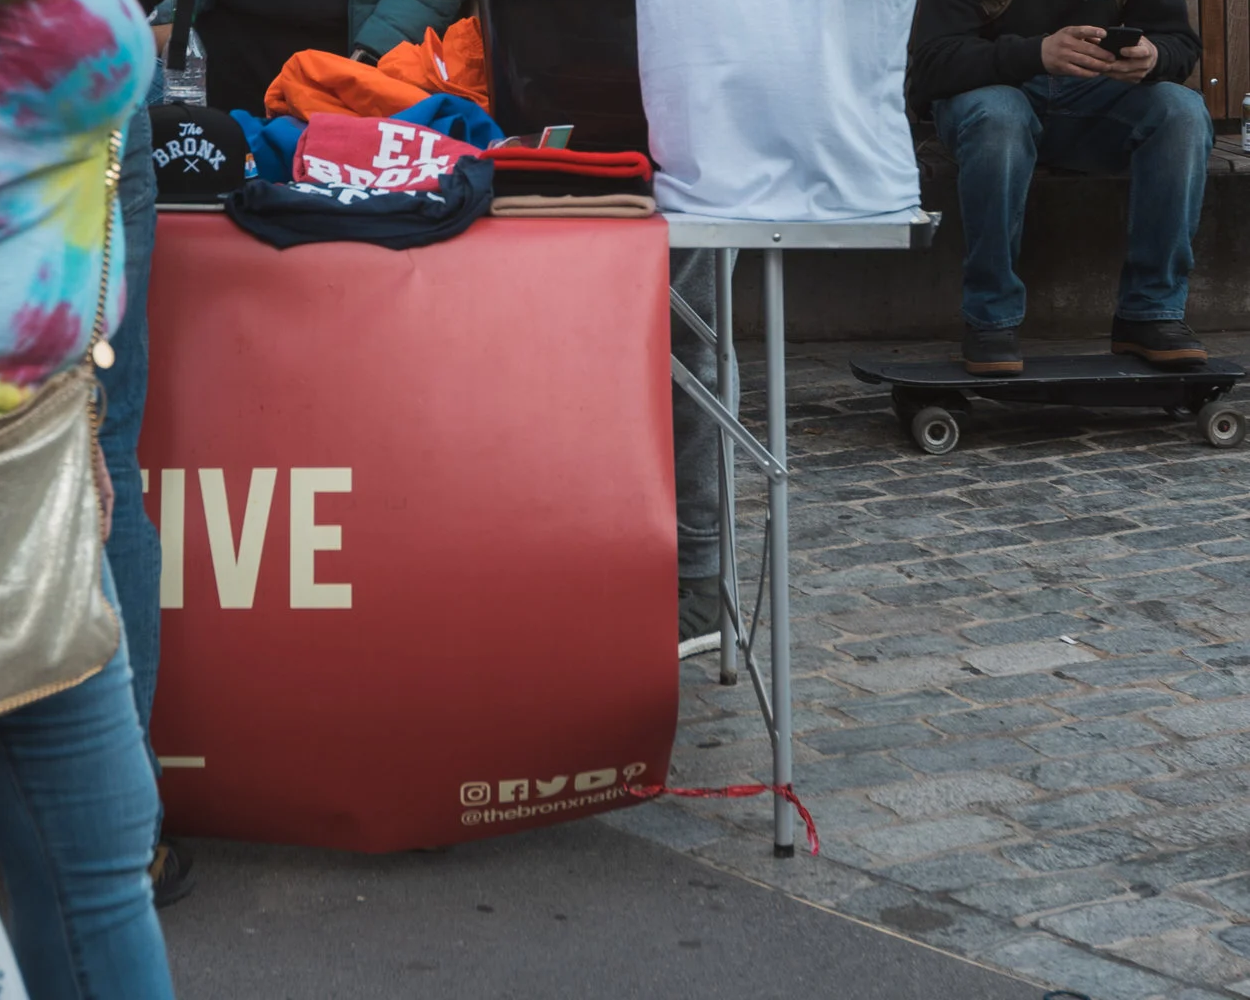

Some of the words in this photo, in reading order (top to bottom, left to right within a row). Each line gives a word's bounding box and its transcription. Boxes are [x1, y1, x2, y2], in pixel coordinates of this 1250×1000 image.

[179, 122, 204, 137] The
[372, 122, 450, 169] EL
[152, 138, 227, 171] BRONX
